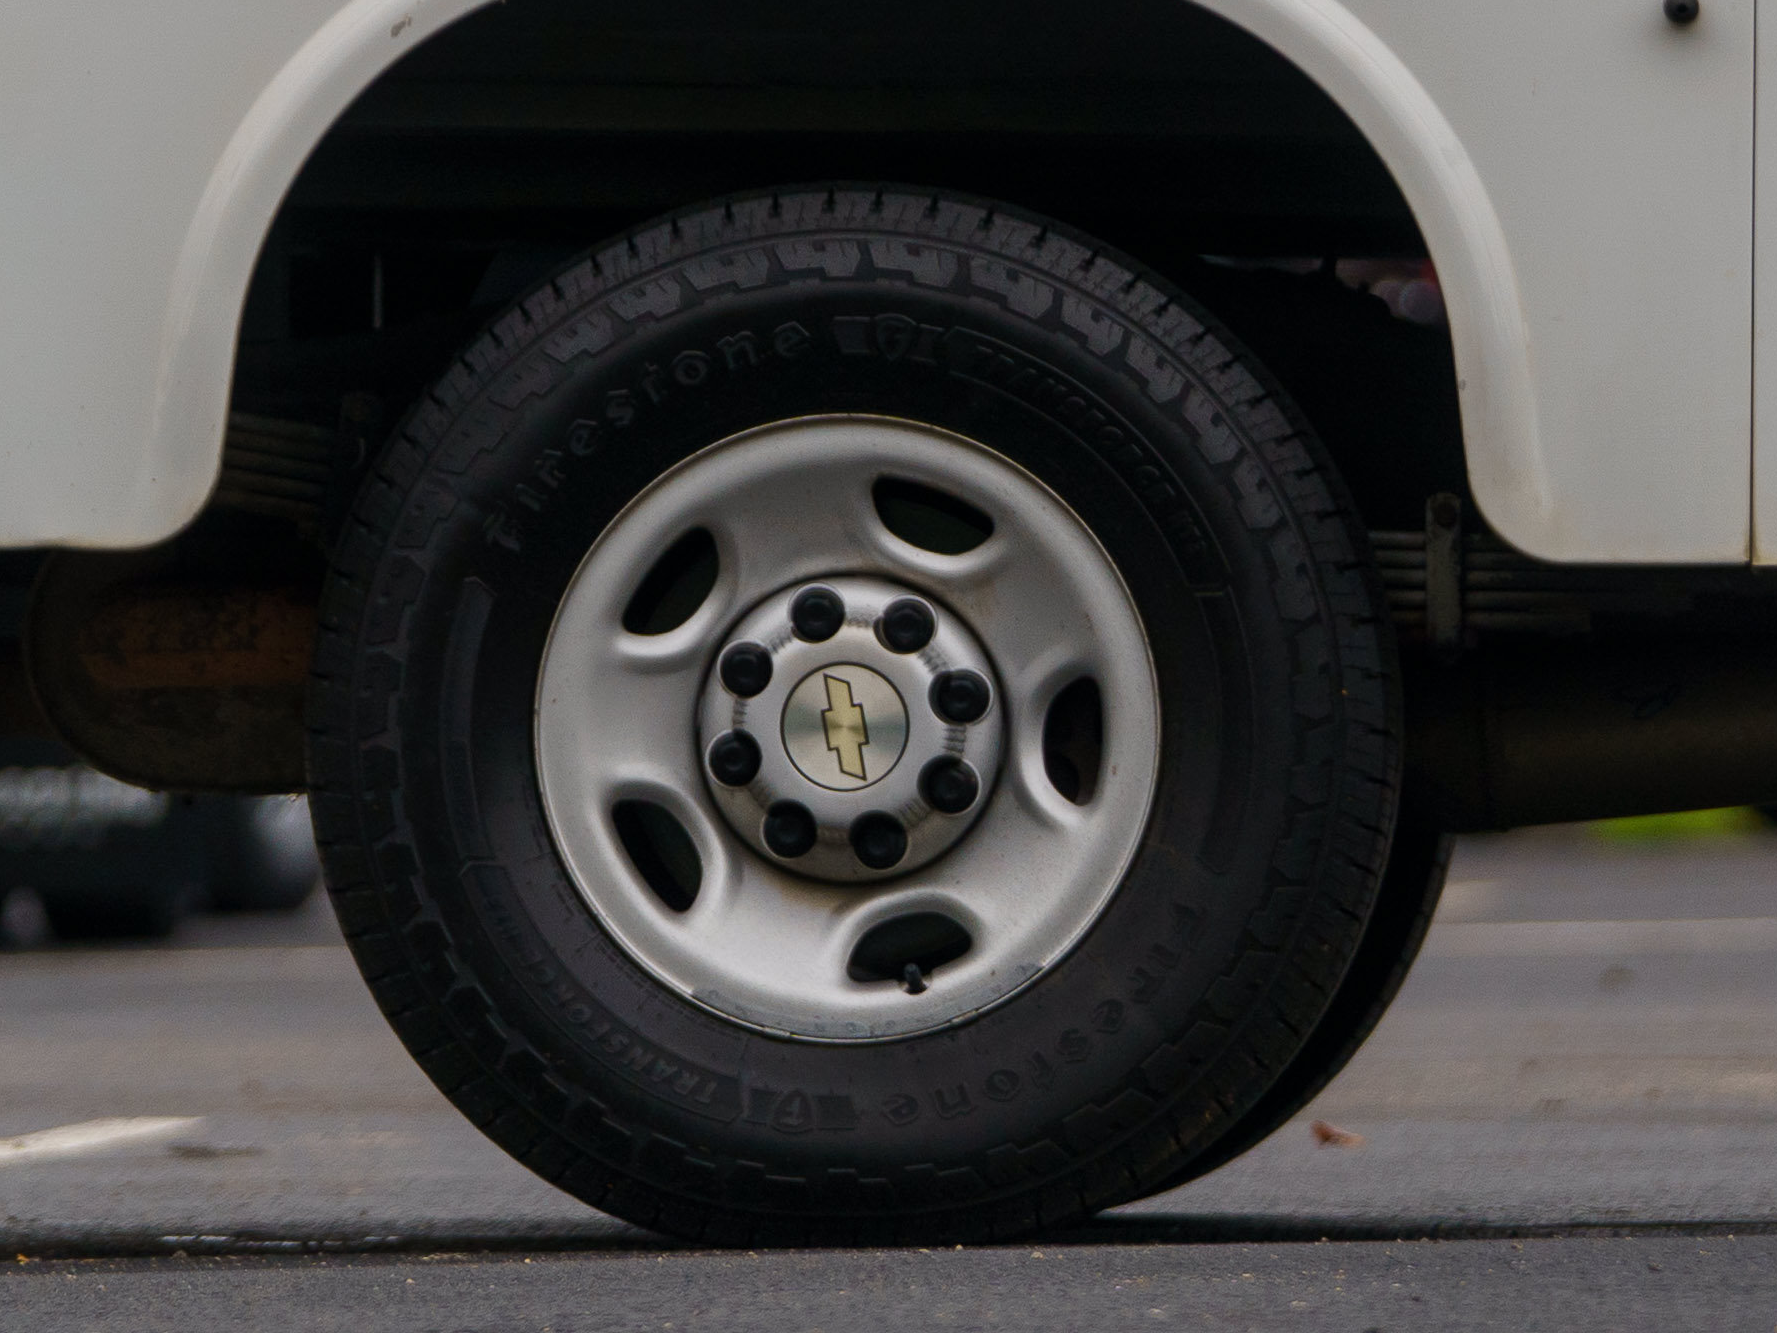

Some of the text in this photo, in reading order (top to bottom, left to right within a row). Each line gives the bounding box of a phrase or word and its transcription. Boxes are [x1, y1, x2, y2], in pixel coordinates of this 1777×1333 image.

[482, 319, 814, 553] Firestone
[512, 938, 719, 1104] TRANSFORCE
[880, 901, 1212, 1129] Firestone
